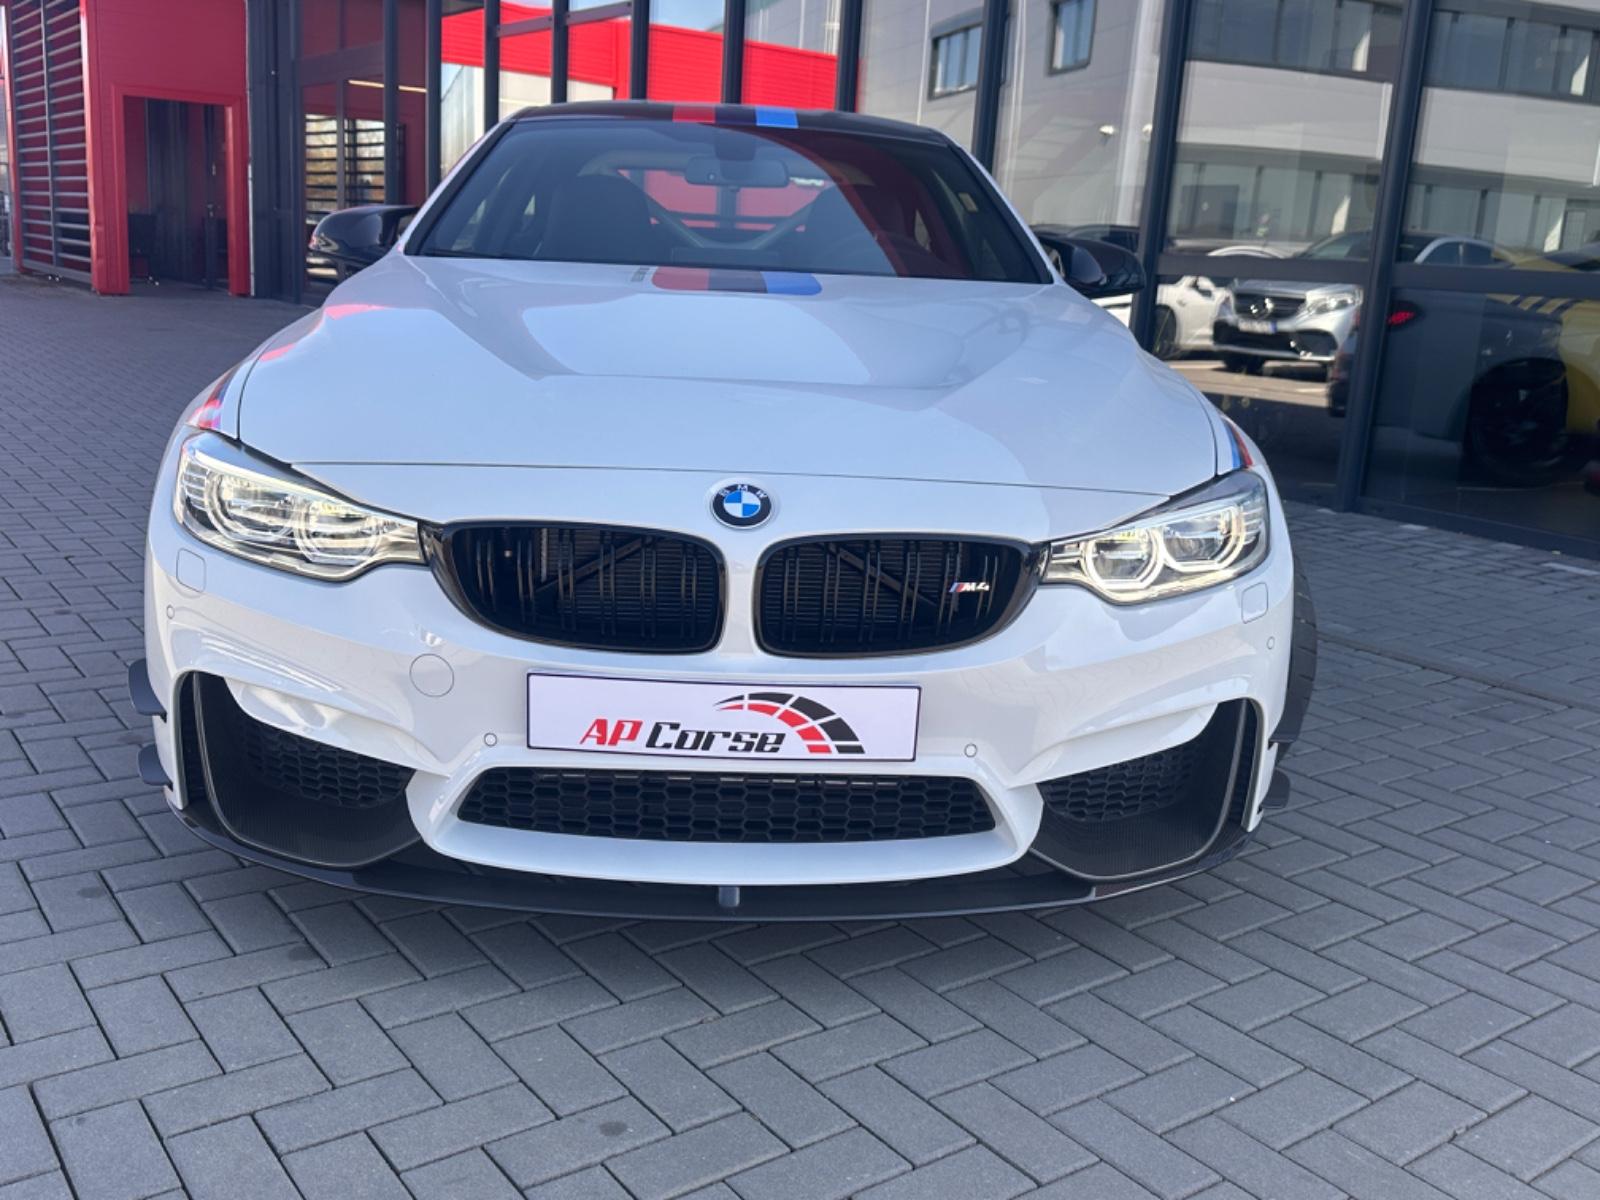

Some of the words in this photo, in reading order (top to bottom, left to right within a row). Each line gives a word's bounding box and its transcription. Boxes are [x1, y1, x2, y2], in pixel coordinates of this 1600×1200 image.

[719, 484, 768, 498] BMW
[954, 582, 990, 592] M4
[580, 718, 643, 746] AP
[645, 721, 786, 753] Corse
